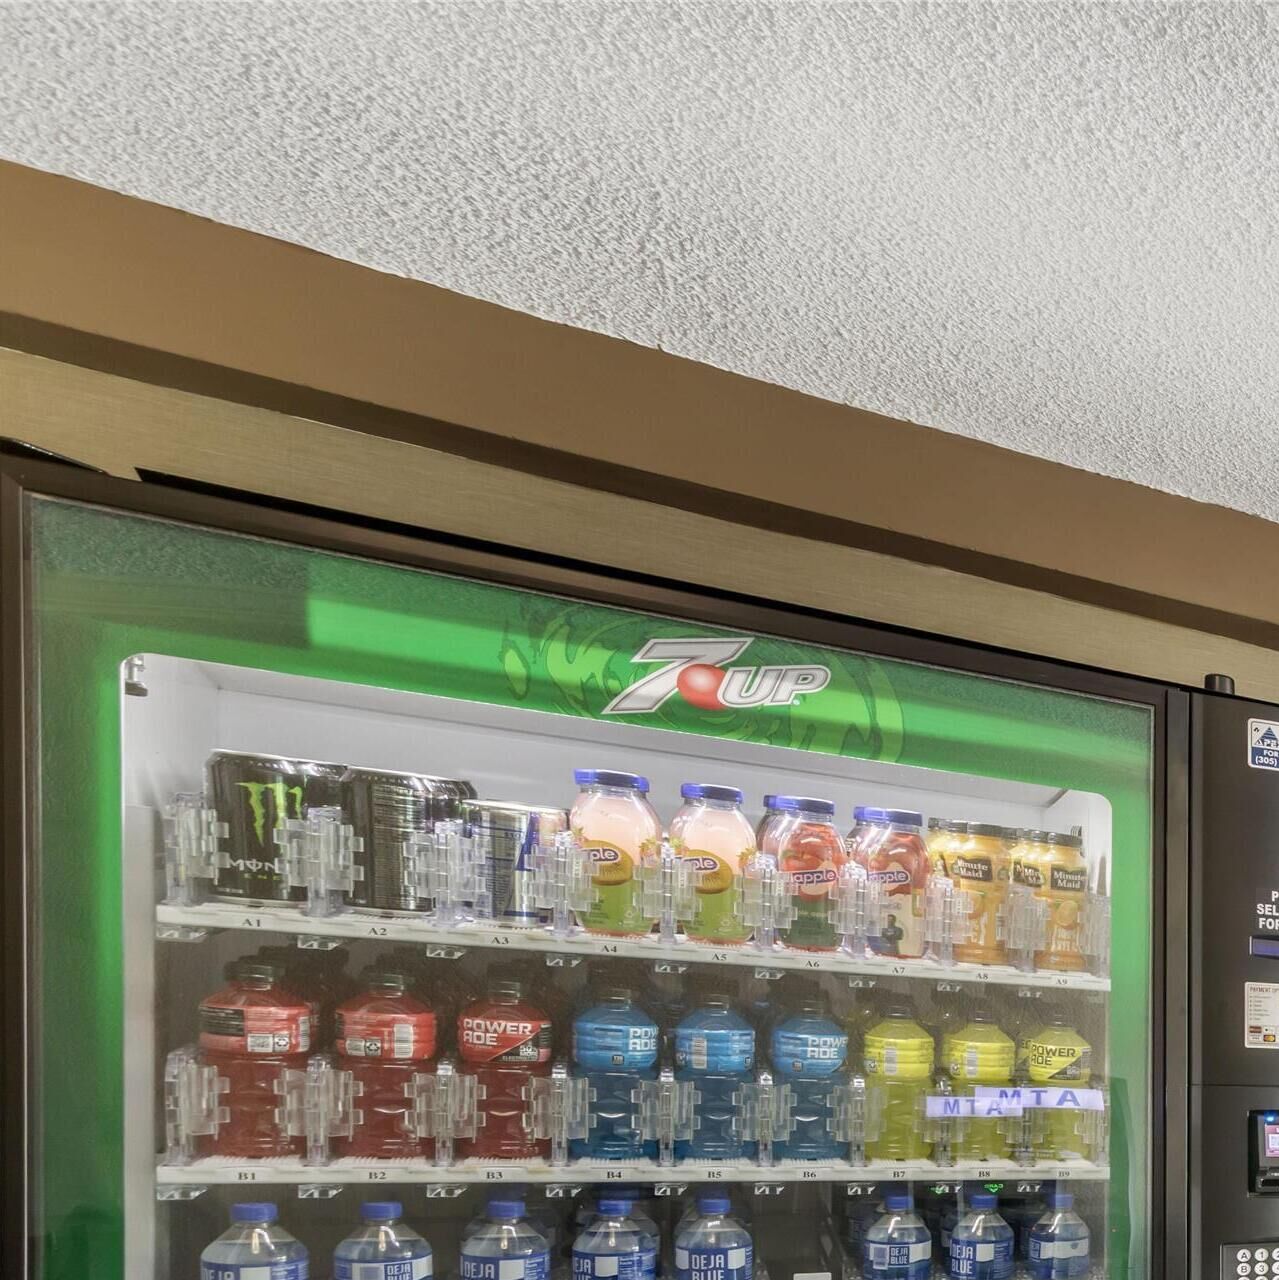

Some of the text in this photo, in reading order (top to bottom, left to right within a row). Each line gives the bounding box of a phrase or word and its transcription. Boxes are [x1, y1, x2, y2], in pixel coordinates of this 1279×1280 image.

[1263, 749, 1279, 757] FOR
[1255, 756, 1278, 766] (305)
[1054, 870, 1086, 882] Minute
[1057, 879, 1081, 889] Maid
[242, 918, 261, 927] A1
[368, 927, 387, 936] A2
[491, 936, 509, 945] A3
[601, 945, 617, 953] A4
[712, 953, 727, 961] A5
[805, 960, 820, 968] A6
[892, 966, 905, 974] A7
[463, 1018, 532, 1035] POWER
[463, 1030, 498, 1045] ADE
[807, 1036, 848, 1048] POWE
[807, 1047, 838, 1058] ADE
[238, 1171, 256, 1180] B1
[368, 1171, 386, 1180] B2
[486, 1170, 503, 1180] B3
[606, 1170, 622, 1179] B4
[707, 1171, 722, 1179] B5
[890, 1246, 909, 1256] DEJA
[951, 1243, 974, 1259] DEJA
[691, 1254, 725, 1270] DEJA
[890, 1255, 909, 1265] BLUE
[387, 1263, 412, 1275] DEJA
[464, 1262, 495, 1279] DEJA
[573, 1257, 592, 1274] EJA
[951, 1258, 974, 1274] BLUE
